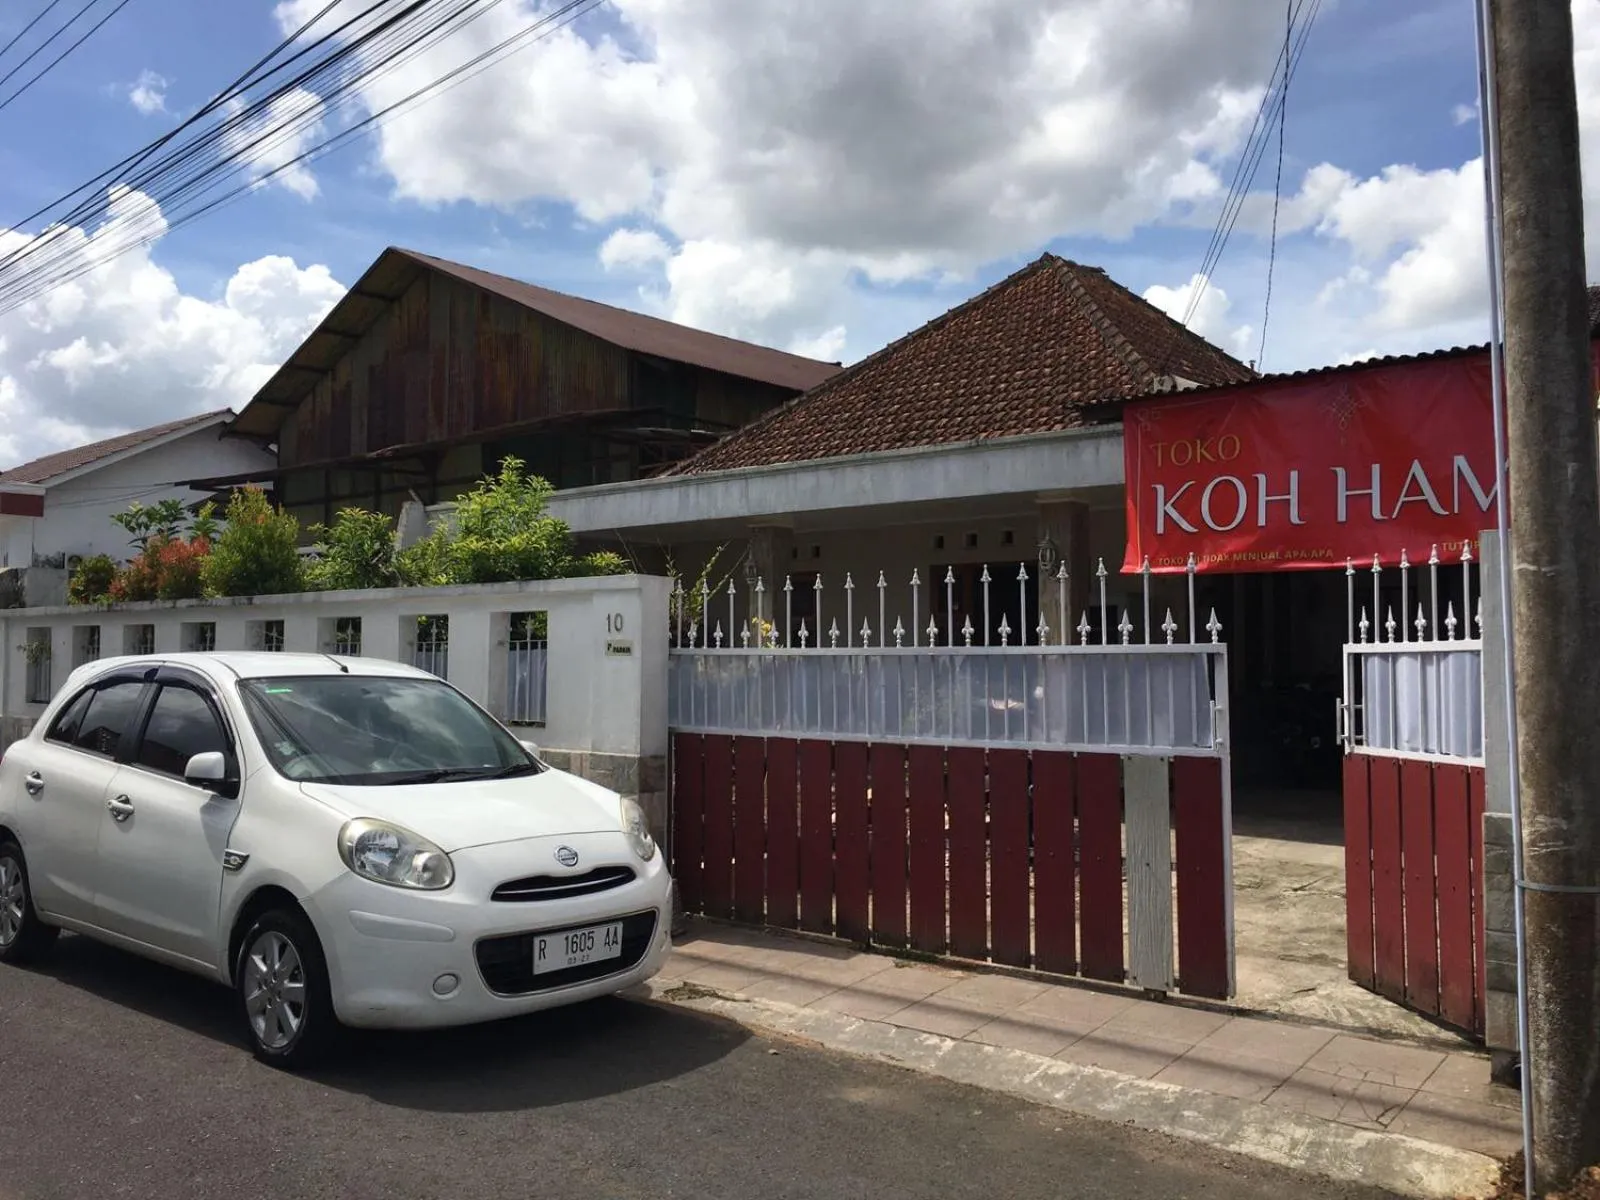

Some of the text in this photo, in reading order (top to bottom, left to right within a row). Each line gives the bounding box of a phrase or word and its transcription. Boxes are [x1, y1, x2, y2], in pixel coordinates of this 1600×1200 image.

[1151, 434, 1241, 468] TOKO
[1151, 470, 1307, 535] KOH
[1157, 556, 1184, 566] TOKO
[1232, 551, 1281, 561] MENJUAL
[606, 612, 623, 633] 10
[538, 926, 619, 961] R 1605 AA
